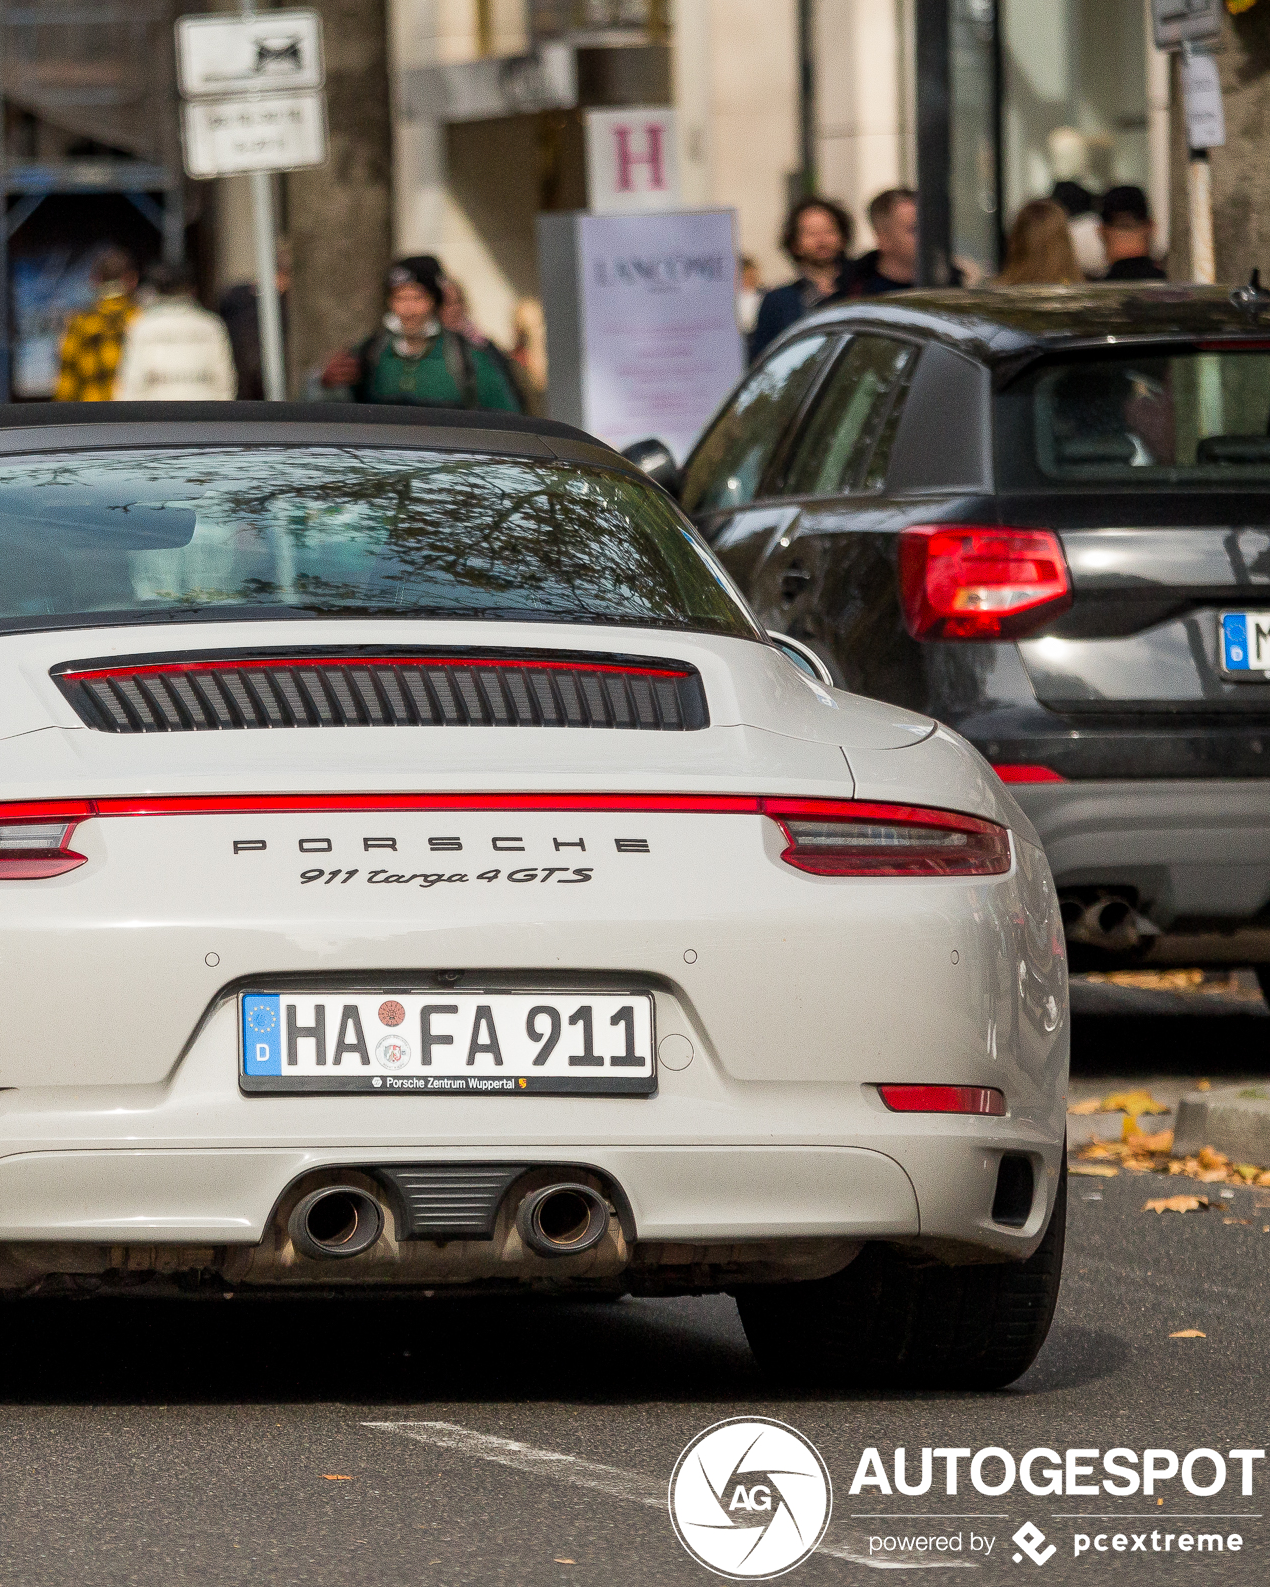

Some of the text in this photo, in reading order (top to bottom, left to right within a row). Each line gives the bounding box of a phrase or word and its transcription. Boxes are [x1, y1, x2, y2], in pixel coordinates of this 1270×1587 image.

[610, 123, 667, 193] H
[232, 837, 651, 855] PORSCHE
[299, 867, 360, 885] 911
[366, 867, 470, 888] targa
[506, 867, 594, 884] GTS
[285, 1004, 371, 1067] HA
[420, 1004, 504, 1067] FA
[525, 1005, 647, 1067] 911
[255, 1043, 270, 1062] D
[386, 1077, 515, 1091] Porsche Zentrum Wuppertal
